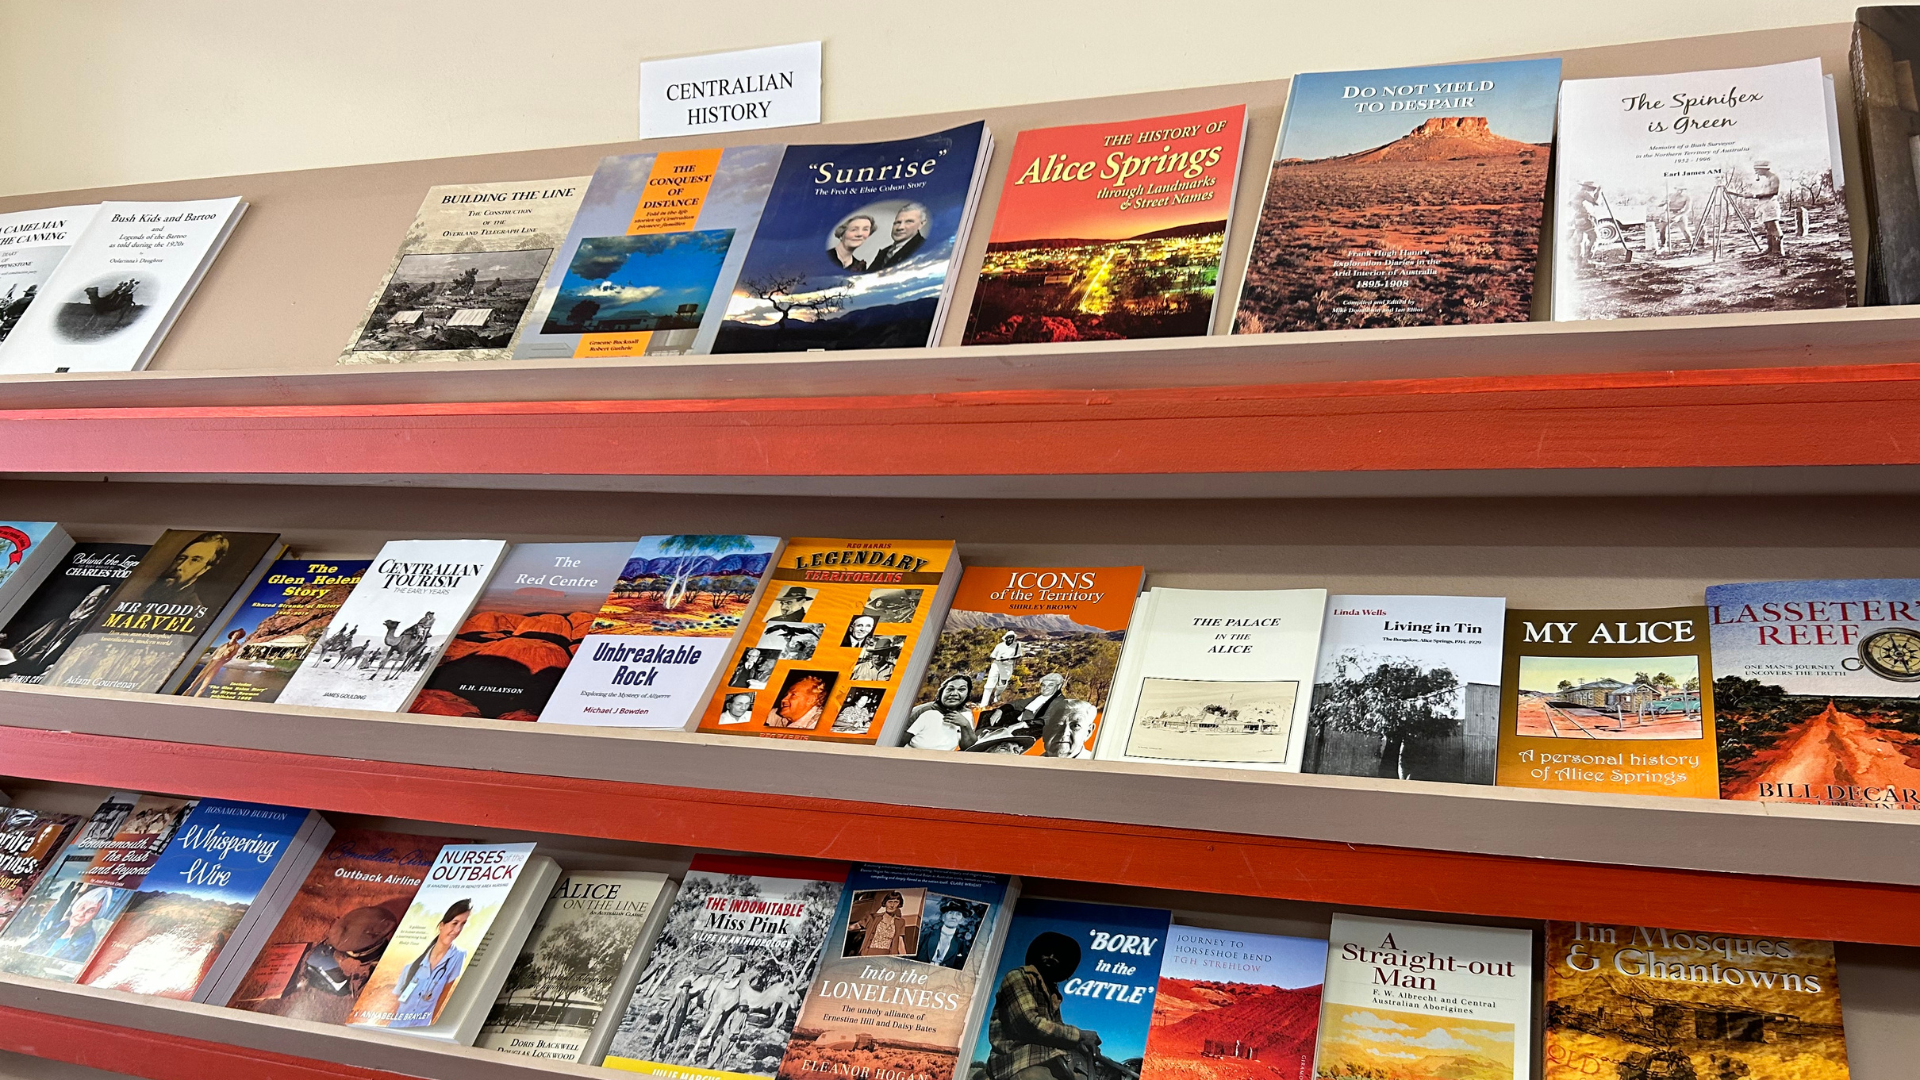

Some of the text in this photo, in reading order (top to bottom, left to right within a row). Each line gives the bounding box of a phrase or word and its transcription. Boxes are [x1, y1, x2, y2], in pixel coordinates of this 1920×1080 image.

[666, 71, 794, 101] CENTRALIAN
[1342, 80, 1495, 99] DO NOT YIELD
[1355, 97, 1475, 114] TO DESPAIR
[1622, 86, 1763, 115] The Spinifex
[687, 100, 772, 126] HISTORY
[1103, 120, 1227, 147] THE HISTORY OF
[1648, 116, 1737, 134] is Green
[673, 164, 697, 173] THE
[808, 149, 948, 184] "Sunrise"
[1014, 145, 1223, 187] Alice Springs
[649, 174, 712, 186] CONQUEST
[1097, 175, 1216, 199] through Landmarks
[441, 187, 576, 204] BUILDING THE LINE
[667, 187, 684, 196] OF
[1119, 189, 1214, 211] & Street Names
[643, 197, 700, 209] DISTANCE
[111, 213, 217, 222] Bush Kids and Bartoo
[3, 219, 68, 235] CAMELMAN
[480, 228, 520, 236] TELEGRAPH
[0, 231, 68, 245] HE CANNING
[1333, 260, 1382, 268] Exploration
[1355, 280, 1410, 289] 1895-1908
[72, 552, 111, 565] Behind
[104, 553, 120, 566] the
[377, 558, 484, 577] CENTRALIAN
[554, 556, 581, 568] The
[795, 550, 928, 573] LEGENDARY
[65, 567, 133, 579] CHARLES TOD
[307, 564, 339, 574] The
[804, 570, 903, 583] TERRITORIANS
[268, 574, 362, 585] Glen Helen
[381, 573, 462, 590] TOURISM
[515, 573, 599, 588] Red Centre
[1006, 571, 1096, 590] ICONS
[282, 586, 331, 599] Story
[990, 589, 1105, 604] of the Territory
[114, 601, 209, 619] MR TODD'S
[1333, 608, 1360, 616] Linda
[102, 613, 196, 633] MARVEL
[1192, 617, 1281, 627] THE PALACE
[1383, 621, 1482, 635] Living in Tin
[1522, 620, 1696, 644] MY ALICE
[1757, 624, 1860, 646] REEF
[592, 642, 702, 665] Unbreakable
[1207, 644, 1253, 654] ALICE
[64, 675, 140, 691] Adam Courtenay
[611, 665, 659, 687] Rock
[1518, 749, 1700, 768] A personal history
[1530, 766, 1688, 785] of Alice Springs
[1758, 782, 1819, 799] BILL
[204, 806, 288, 821] ROSAMUND BURTON
[78, 837, 150, 850] Bournemouth,
[177, 823, 280, 863] Whispering
[102, 849, 122, 862] The
[122, 850, 152, 862] Bush
[439, 850, 524, 865] NURSES of the
[111, 863, 156, 881] Beyond
[179, 857, 232, 887] Wire
[334, 867, 383, 883] Outback
[384, 874, 421, 887] Airline
[432, 864, 519, 881] OUTBACK
[551, 877, 622, 900] ALICE
[563, 899, 649, 913] ON THE LINE
[705, 897, 806, 917] THE INDOMITABLE
[704, 912, 790, 935] Miss Pink
[1089, 929, 1158, 956] 'BORN
[1177, 934, 1244, 948] JOURNEY TO
[1378, 932, 1400, 950] A
[1572, 921, 1793, 960] Tin Mosques
[1175, 945, 1272, 963] HORSESHOE BEND
[1341, 942, 1516, 978] Straight-out
[859, 964, 929, 985] Into the
[1202, 959, 1262, 972] STREHLOW
[1565, 944, 1822, 994] & Ghantowns
[1371, 967, 1438, 991] Man
[819, 980, 960, 1011] LONELINESS
[1063, 978, 1155, 1004] CATTLE'
[841, 1004, 926, 1021] The unholy alliance of
[1371, 997, 1474, 1015] Australian Aborigines
[823, 1013, 937, 1033] Ernestine Hill and Daisy Bates
[510, 1038, 579, 1051] DORIS BLACKWELL
[801, 1059, 870, 1078] ELEANOR
